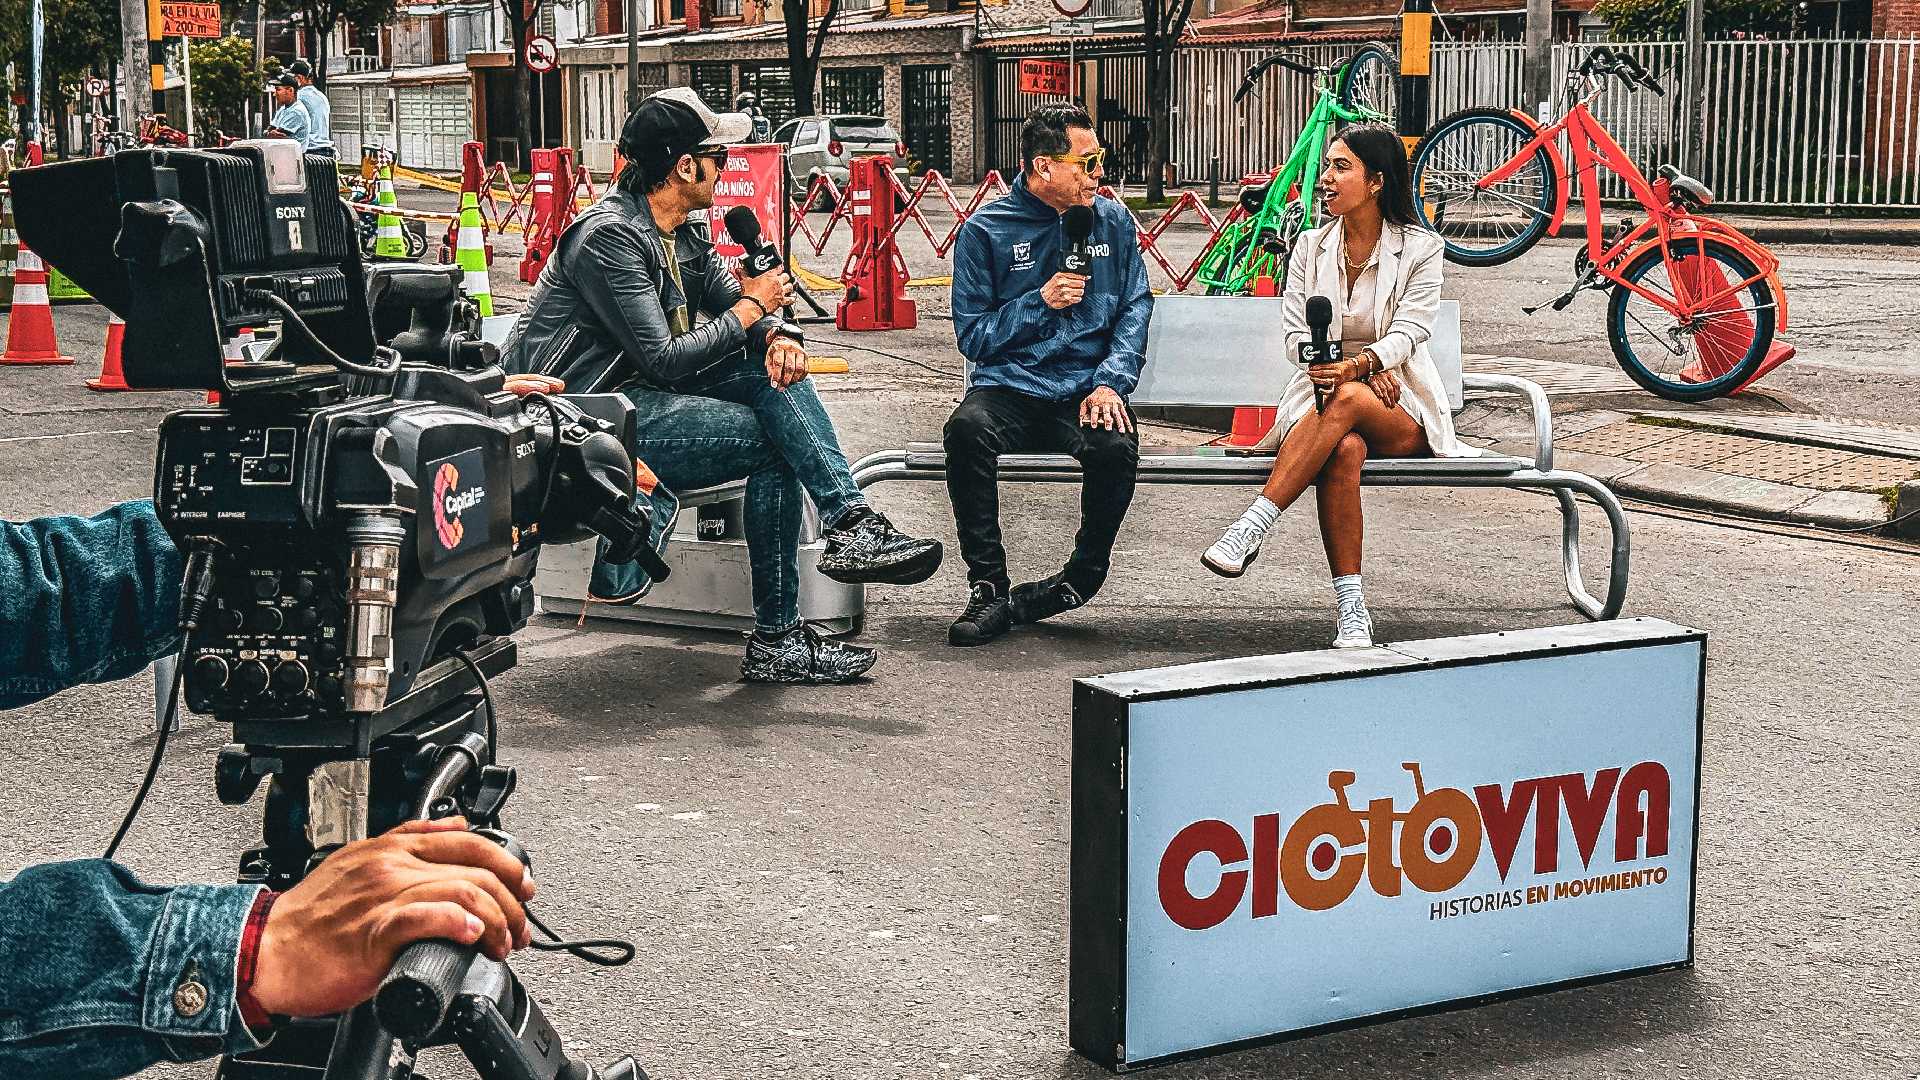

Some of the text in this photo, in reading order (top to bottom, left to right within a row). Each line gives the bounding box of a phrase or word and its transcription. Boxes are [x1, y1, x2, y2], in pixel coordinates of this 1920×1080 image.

[176, 5, 188, 18] EN
[190, 6, 200, 19] LA
[203, 7, 217, 19] VIA
[164, 20, 207, 34] A 200 m
[730, 177, 755, 197] NIÑOS
[275, 206, 306, 219] SONY
[445, 486, 475, 516] Capital
[1429, 867, 1668, 920] HISTORIAS EN MOVIMIENTO
